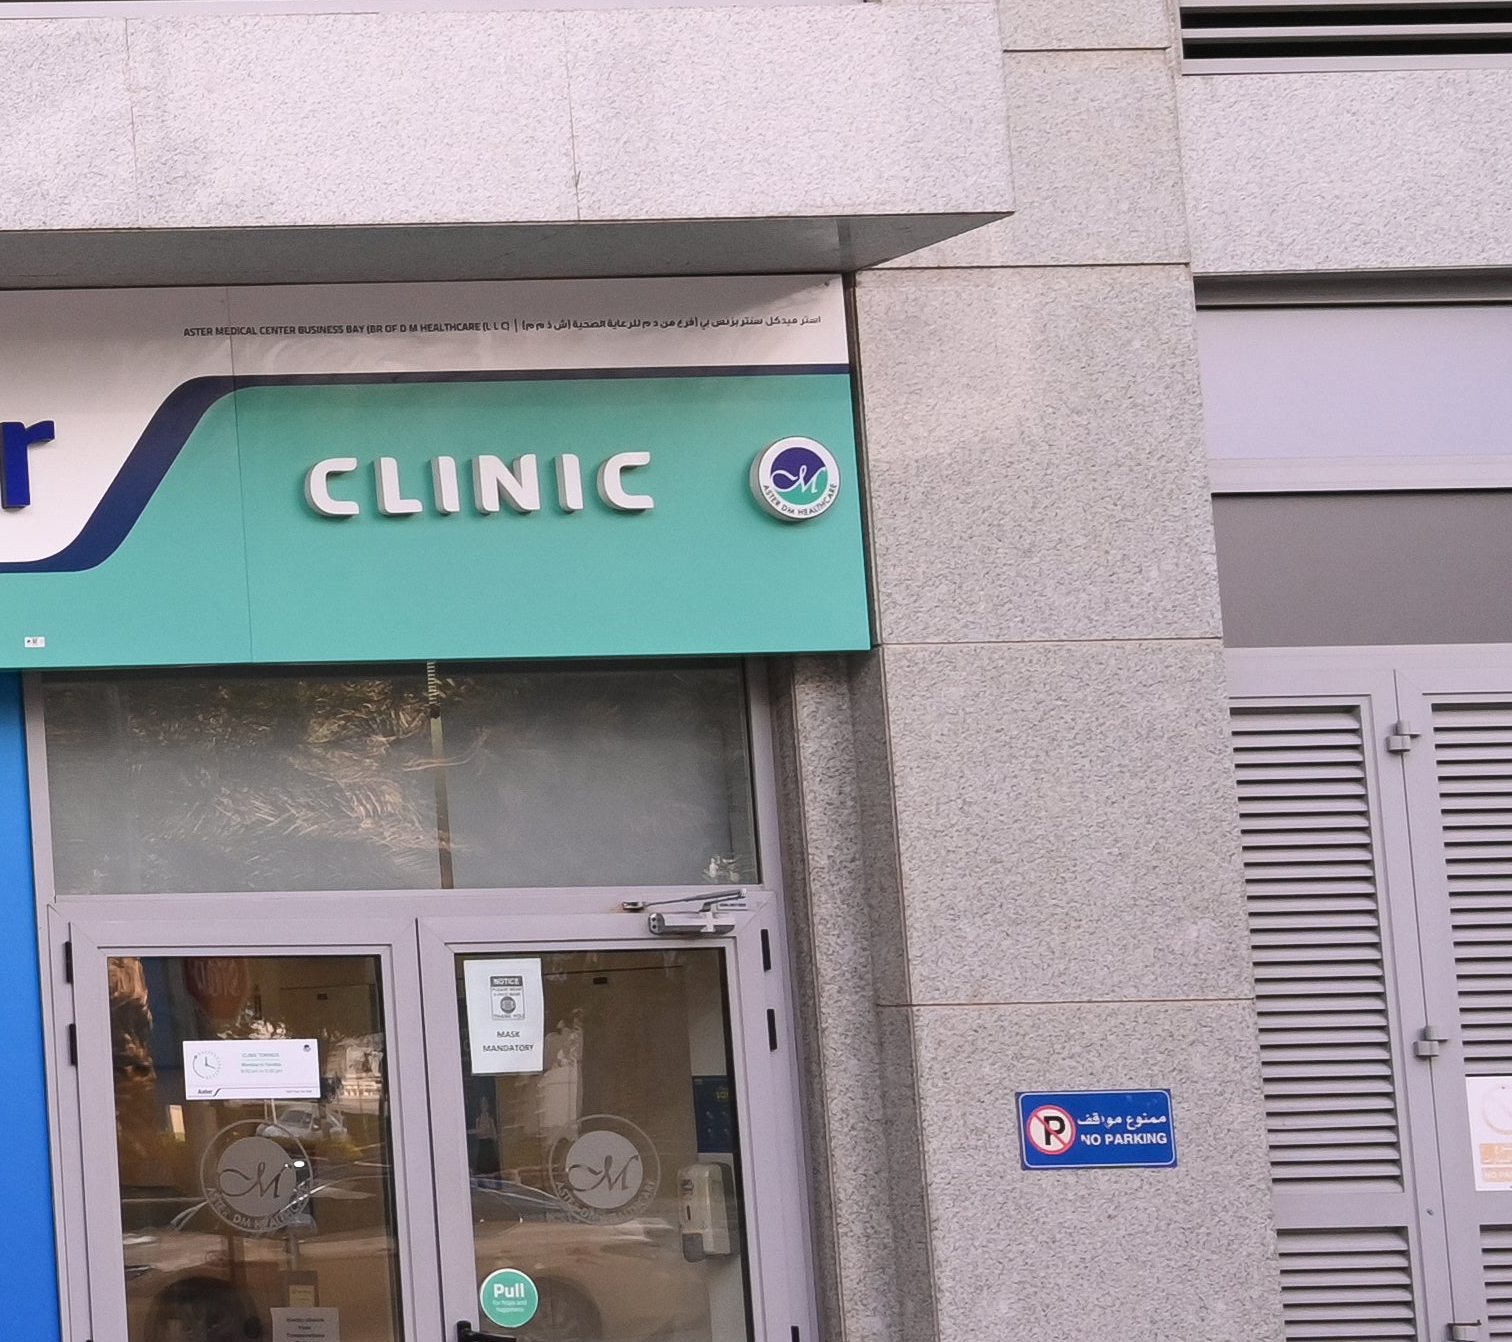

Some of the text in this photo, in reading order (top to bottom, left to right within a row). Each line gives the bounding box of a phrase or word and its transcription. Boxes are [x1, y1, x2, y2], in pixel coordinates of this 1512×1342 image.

[183, 327, 213, 337] ASTER
[215, 326, 257, 336] MEDICAL
[259, 326, 296, 335] CENTER
[298, 325, 344, 335] BUSINESS
[346, 324, 365, 334] BAY
[366, 323, 383, 334] (BR
[384, 324, 398, 333] OF
[400, 324, 407, 332] D
[409, 323, 418, 332] M
[420, 322, 481, 333] HEALTHCARE
[304, 451, 655, 516] CLINIC
[763, 483, 838, 516] ASTER DM HEALTHCARE
[496, 1030, 521, 1038] MASK
[482, 1044, 534, 1052] MANDATORY
[1077, 1112, 1167, 1131] ممنوع مواقف
[1080, 1132, 1168, 1146] NO PARKING
[493, 1282, 525, 1298] Pull
